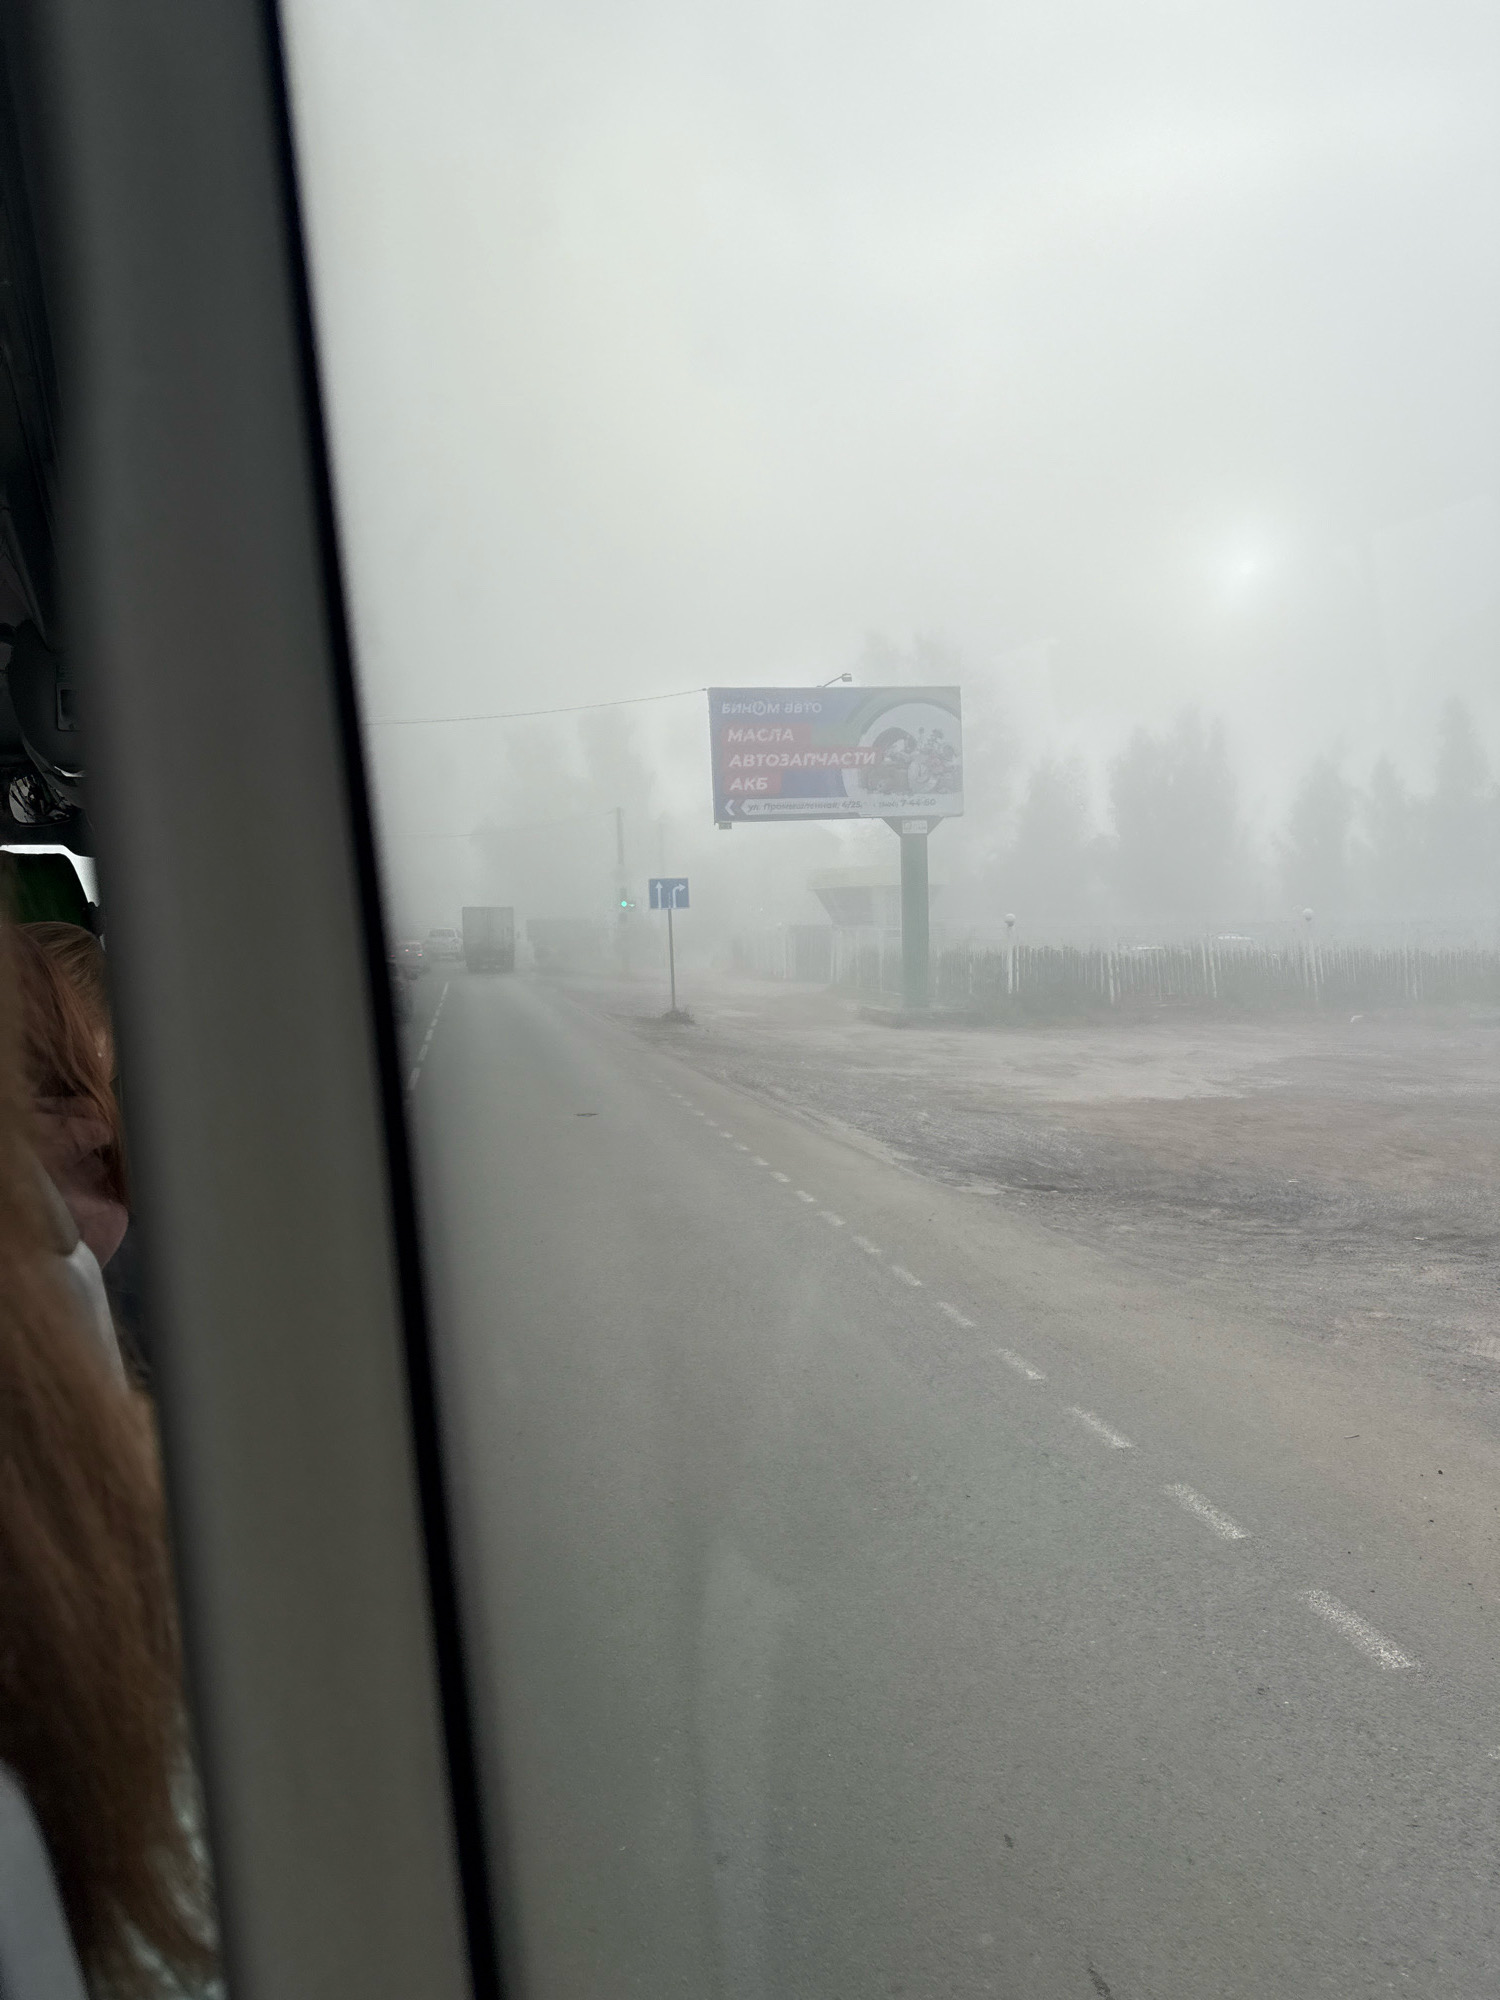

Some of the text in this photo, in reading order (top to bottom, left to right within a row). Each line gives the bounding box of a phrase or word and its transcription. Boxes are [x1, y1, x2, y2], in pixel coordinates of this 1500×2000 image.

[727, 727, 795, 742] МАСЛА
[728, 750, 876, 766] АВТОЗАПЧАСТИ
[729, 776, 768, 791] АКБ
